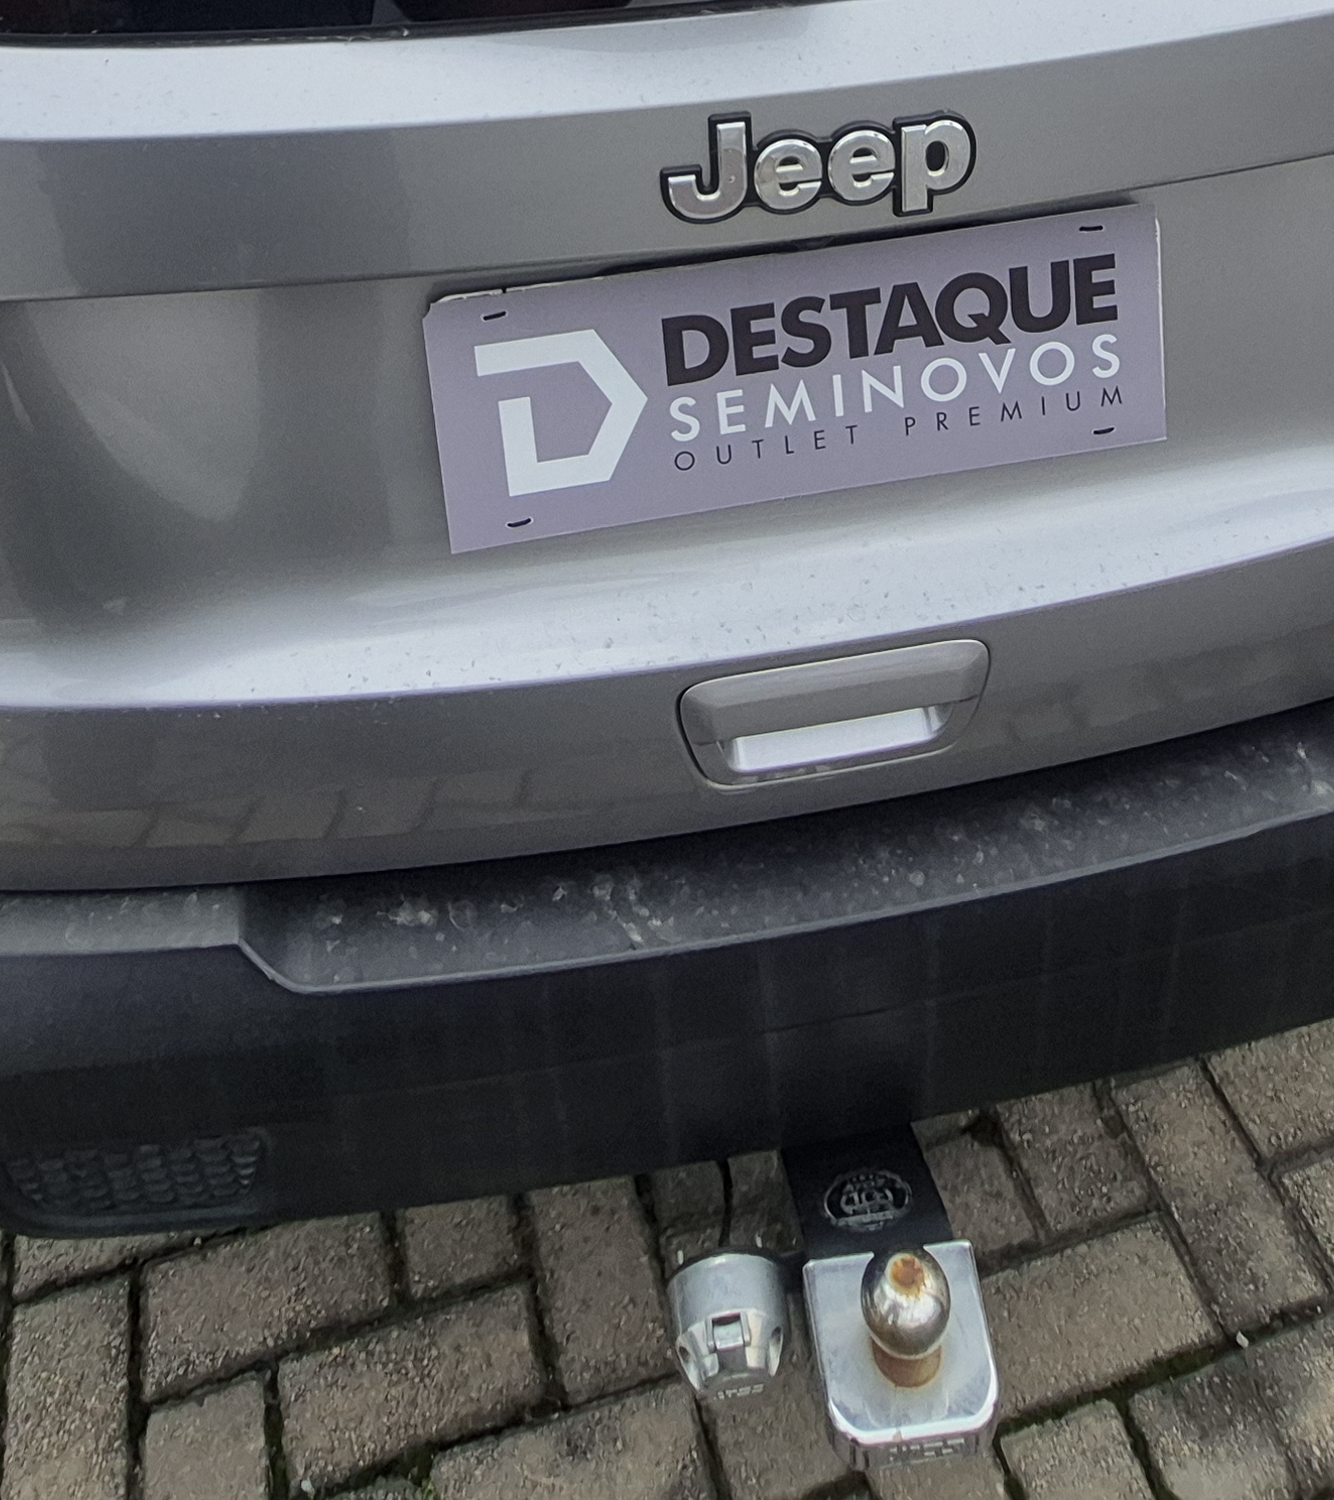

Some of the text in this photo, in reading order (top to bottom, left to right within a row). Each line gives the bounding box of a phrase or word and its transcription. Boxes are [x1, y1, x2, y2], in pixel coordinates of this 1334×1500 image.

[661, 111, 976, 224] Jeep
[661, 252, 1120, 388] DESTAQUE
[669, 333, 1122, 443] SEMINOVOS
[673, 385, 1124, 472] OUTLET PREMIUM
